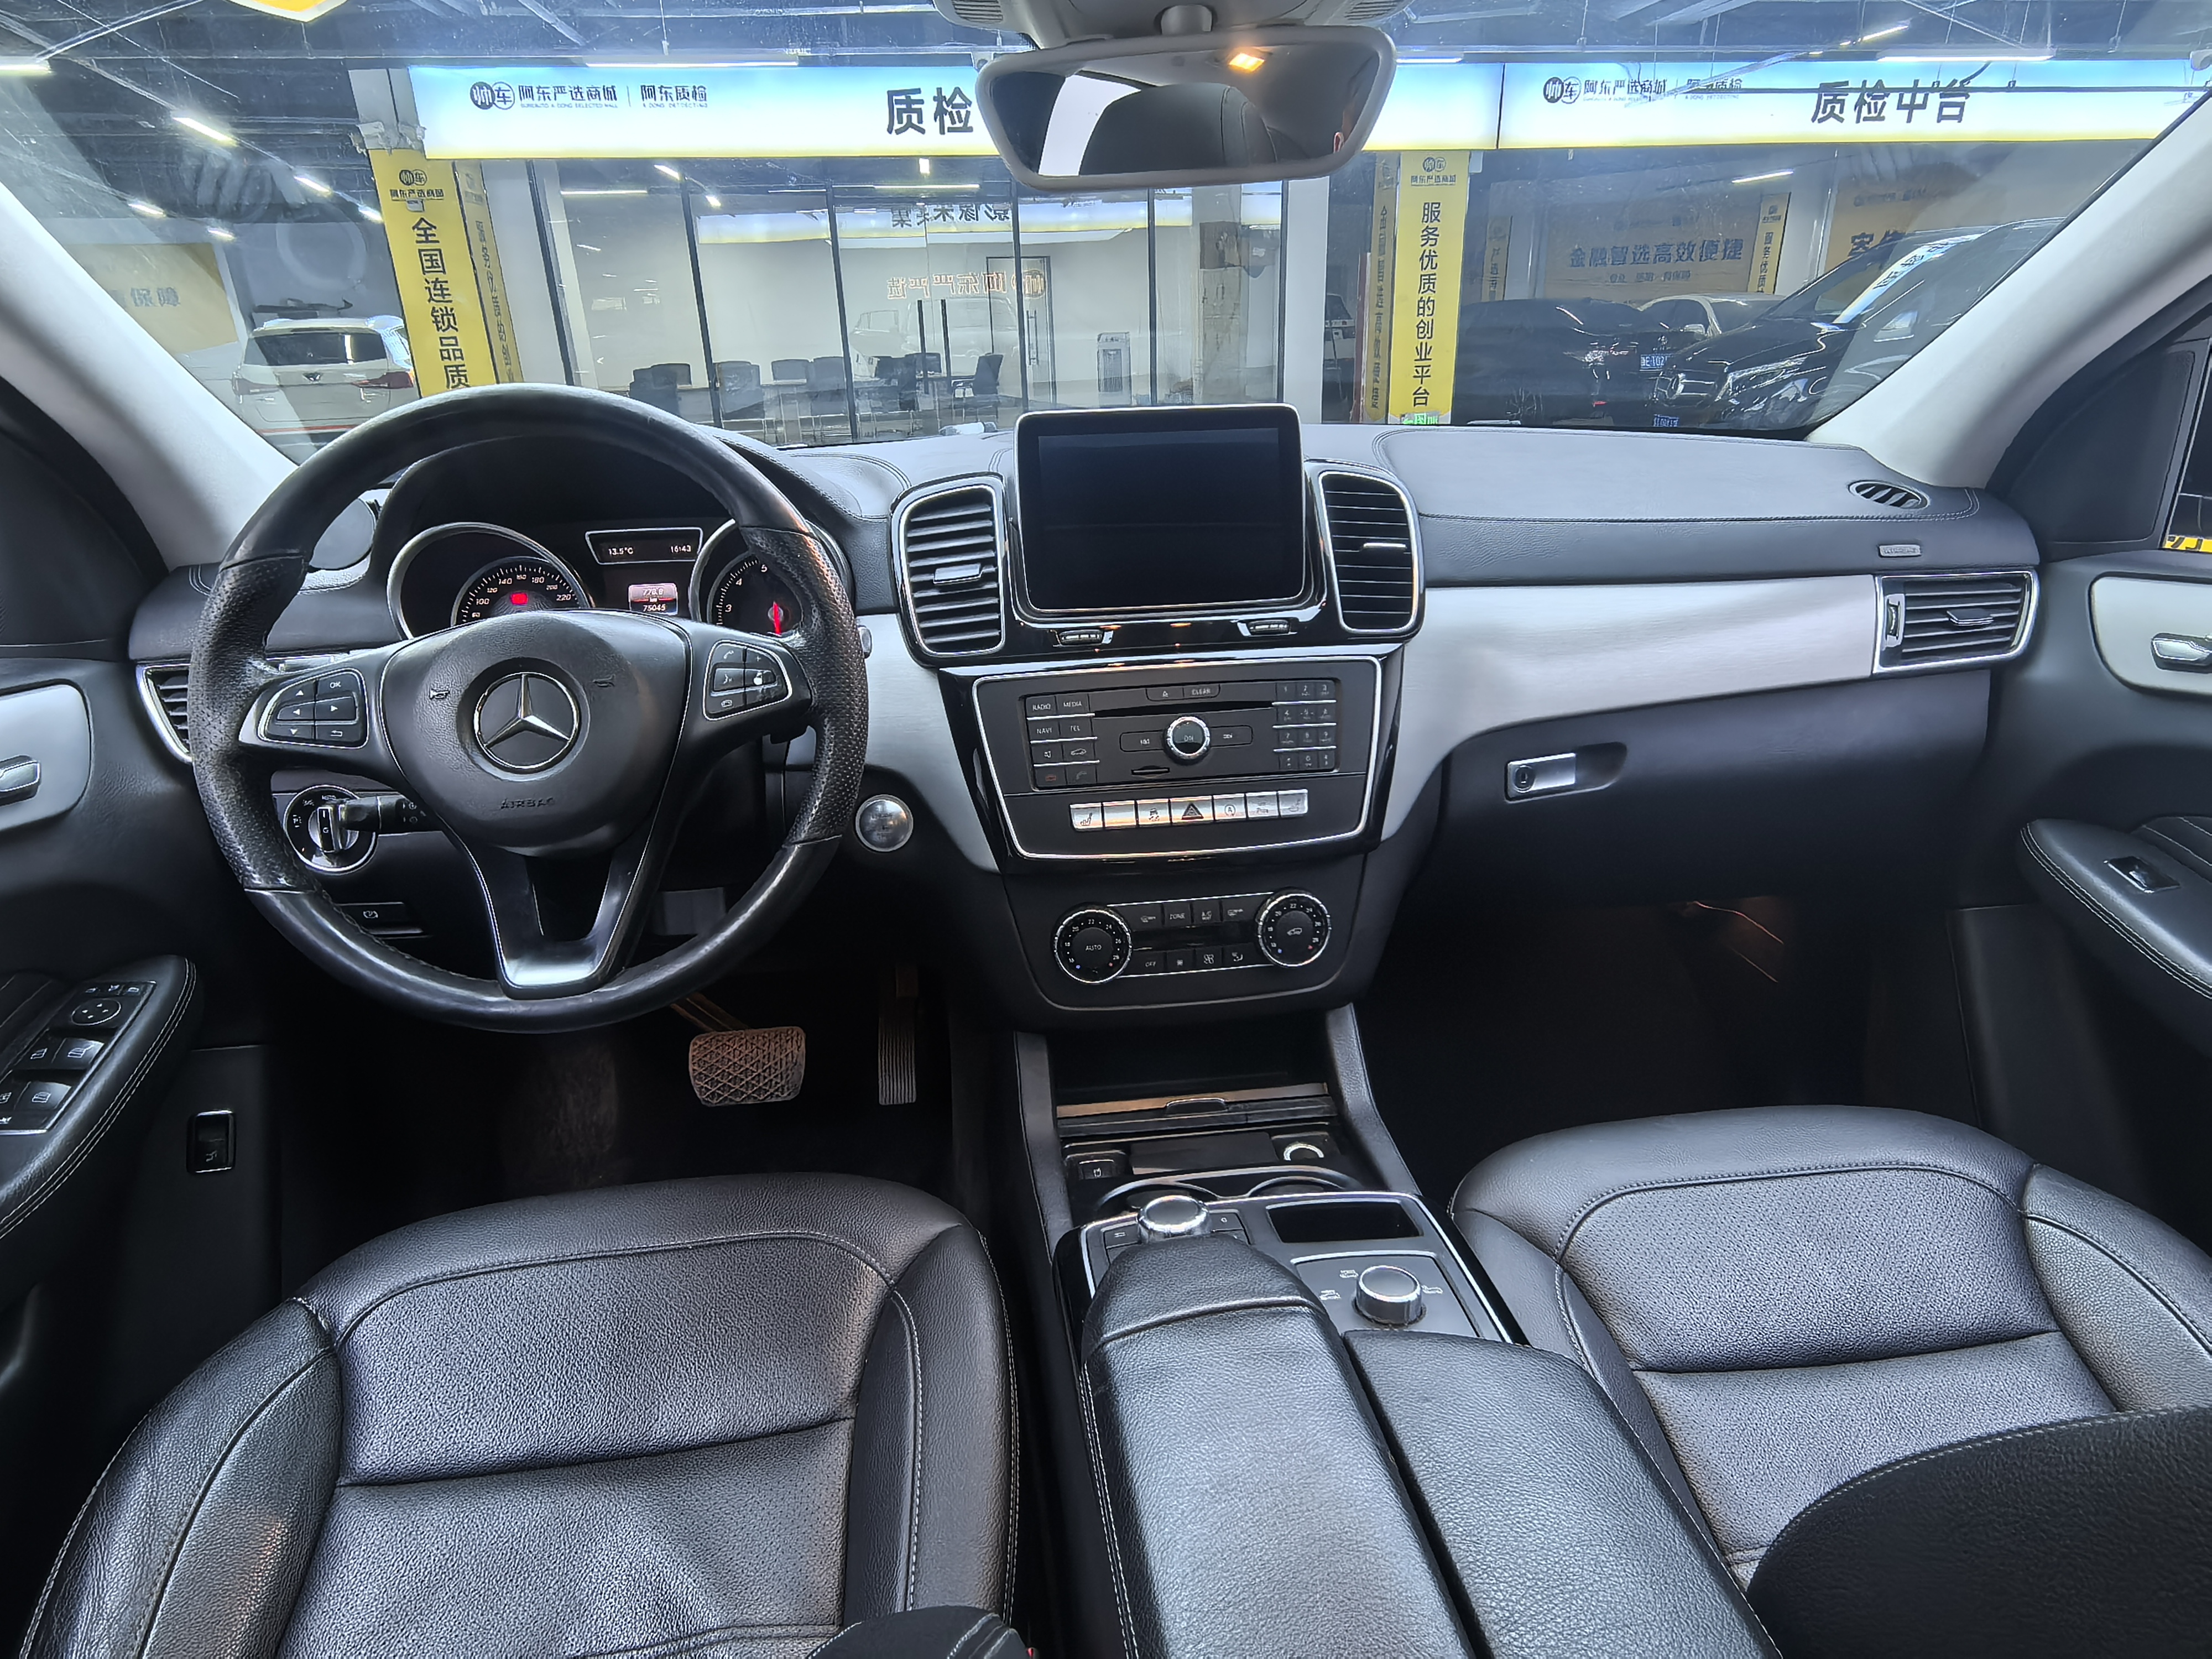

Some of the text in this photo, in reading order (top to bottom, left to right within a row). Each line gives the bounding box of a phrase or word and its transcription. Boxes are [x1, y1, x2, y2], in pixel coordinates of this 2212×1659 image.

[518, 85, 618, 102] 阿东严选商城
[640, 85, 707, 102] 阿东质检
[1811, 79, 1970, 124] 质检中台
[411, 217, 471, 389] 全国连锁品质
[1411, 202, 1441, 408] 服务优质的创业平台
[608, 545, 692, 556] 13.5°C 16:43
[760, 564, 768, 573] 5
[735, 577, 743, 586] 4
[724, 604, 732, 612] 3
[1032, 703, 1051, 711] RADIO
[500, 797, 555, 810] AIRBAG
